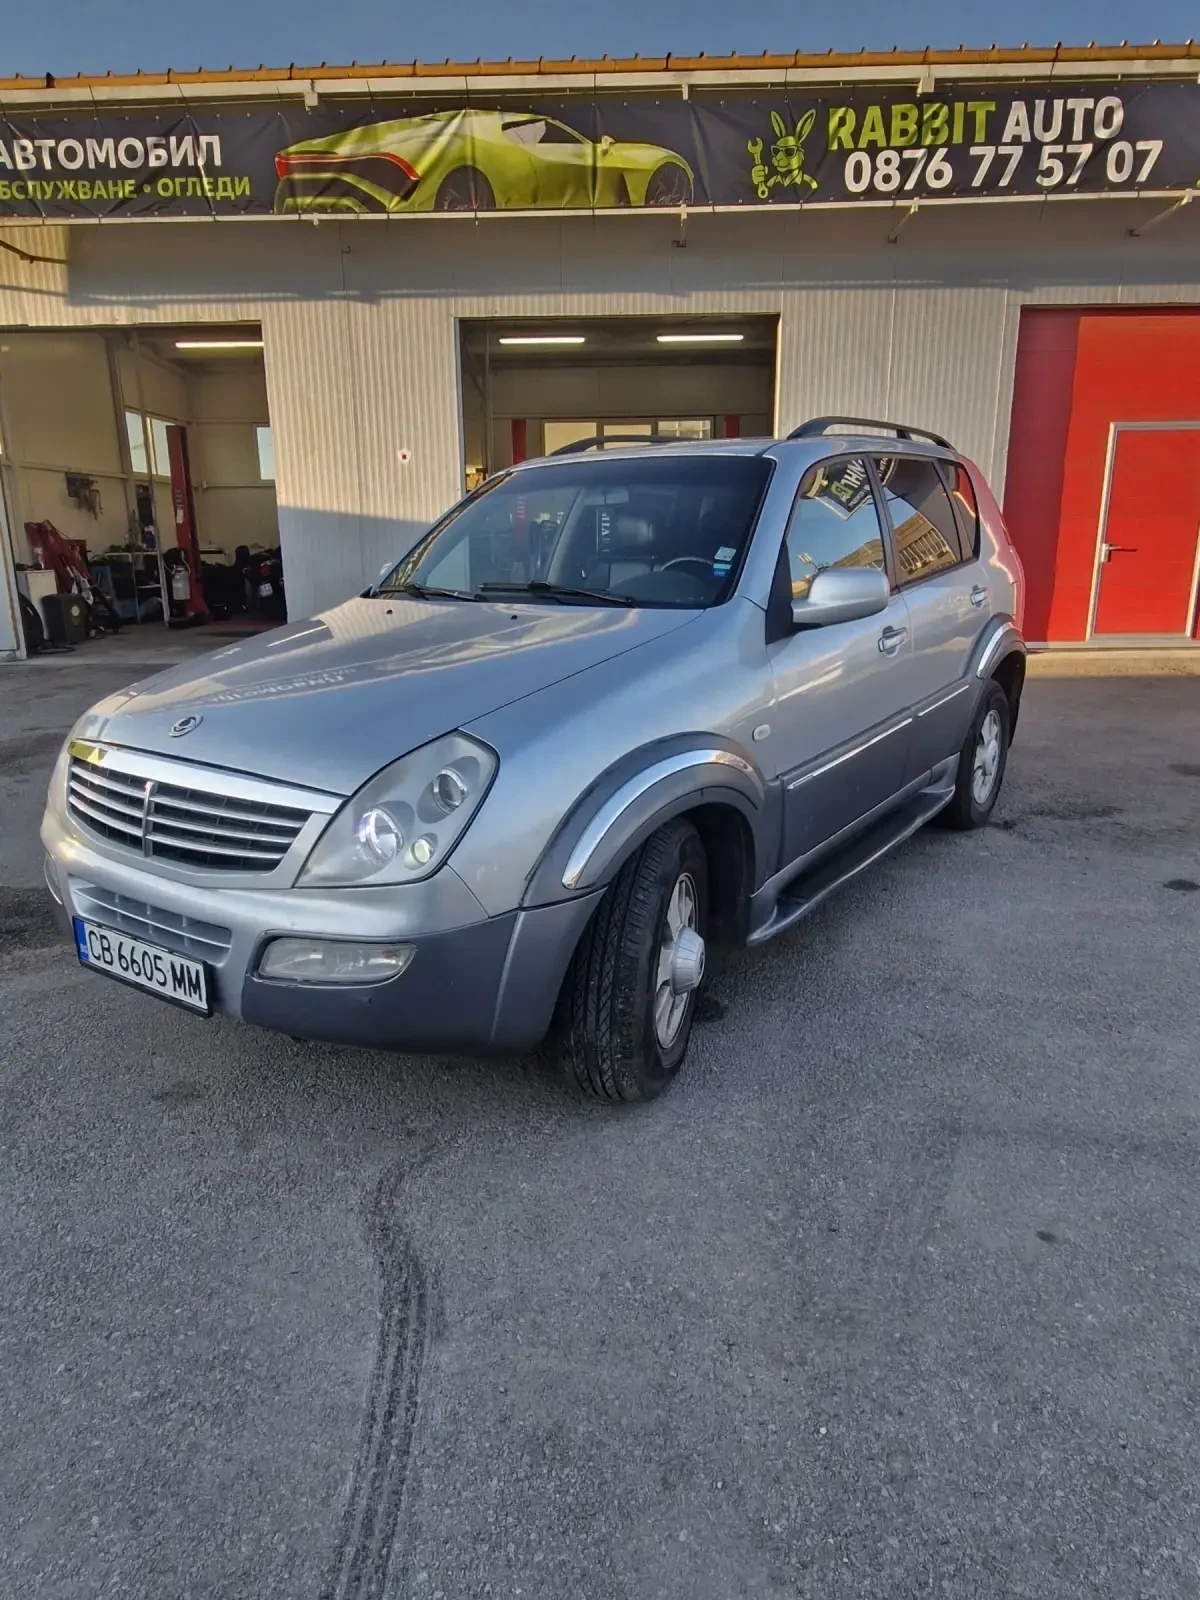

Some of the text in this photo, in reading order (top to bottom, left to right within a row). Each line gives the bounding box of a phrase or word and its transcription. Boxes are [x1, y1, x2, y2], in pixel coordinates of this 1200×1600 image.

[828, 96, 1124, 150] RABBIT AUTO
[157, 176, 250, 200] ОГЛЕДИ
[845, 141, 1163, 192] 0876 77 57 07
[118, 941, 167, 986] 6605
[170, 960, 202, 1002] MM
